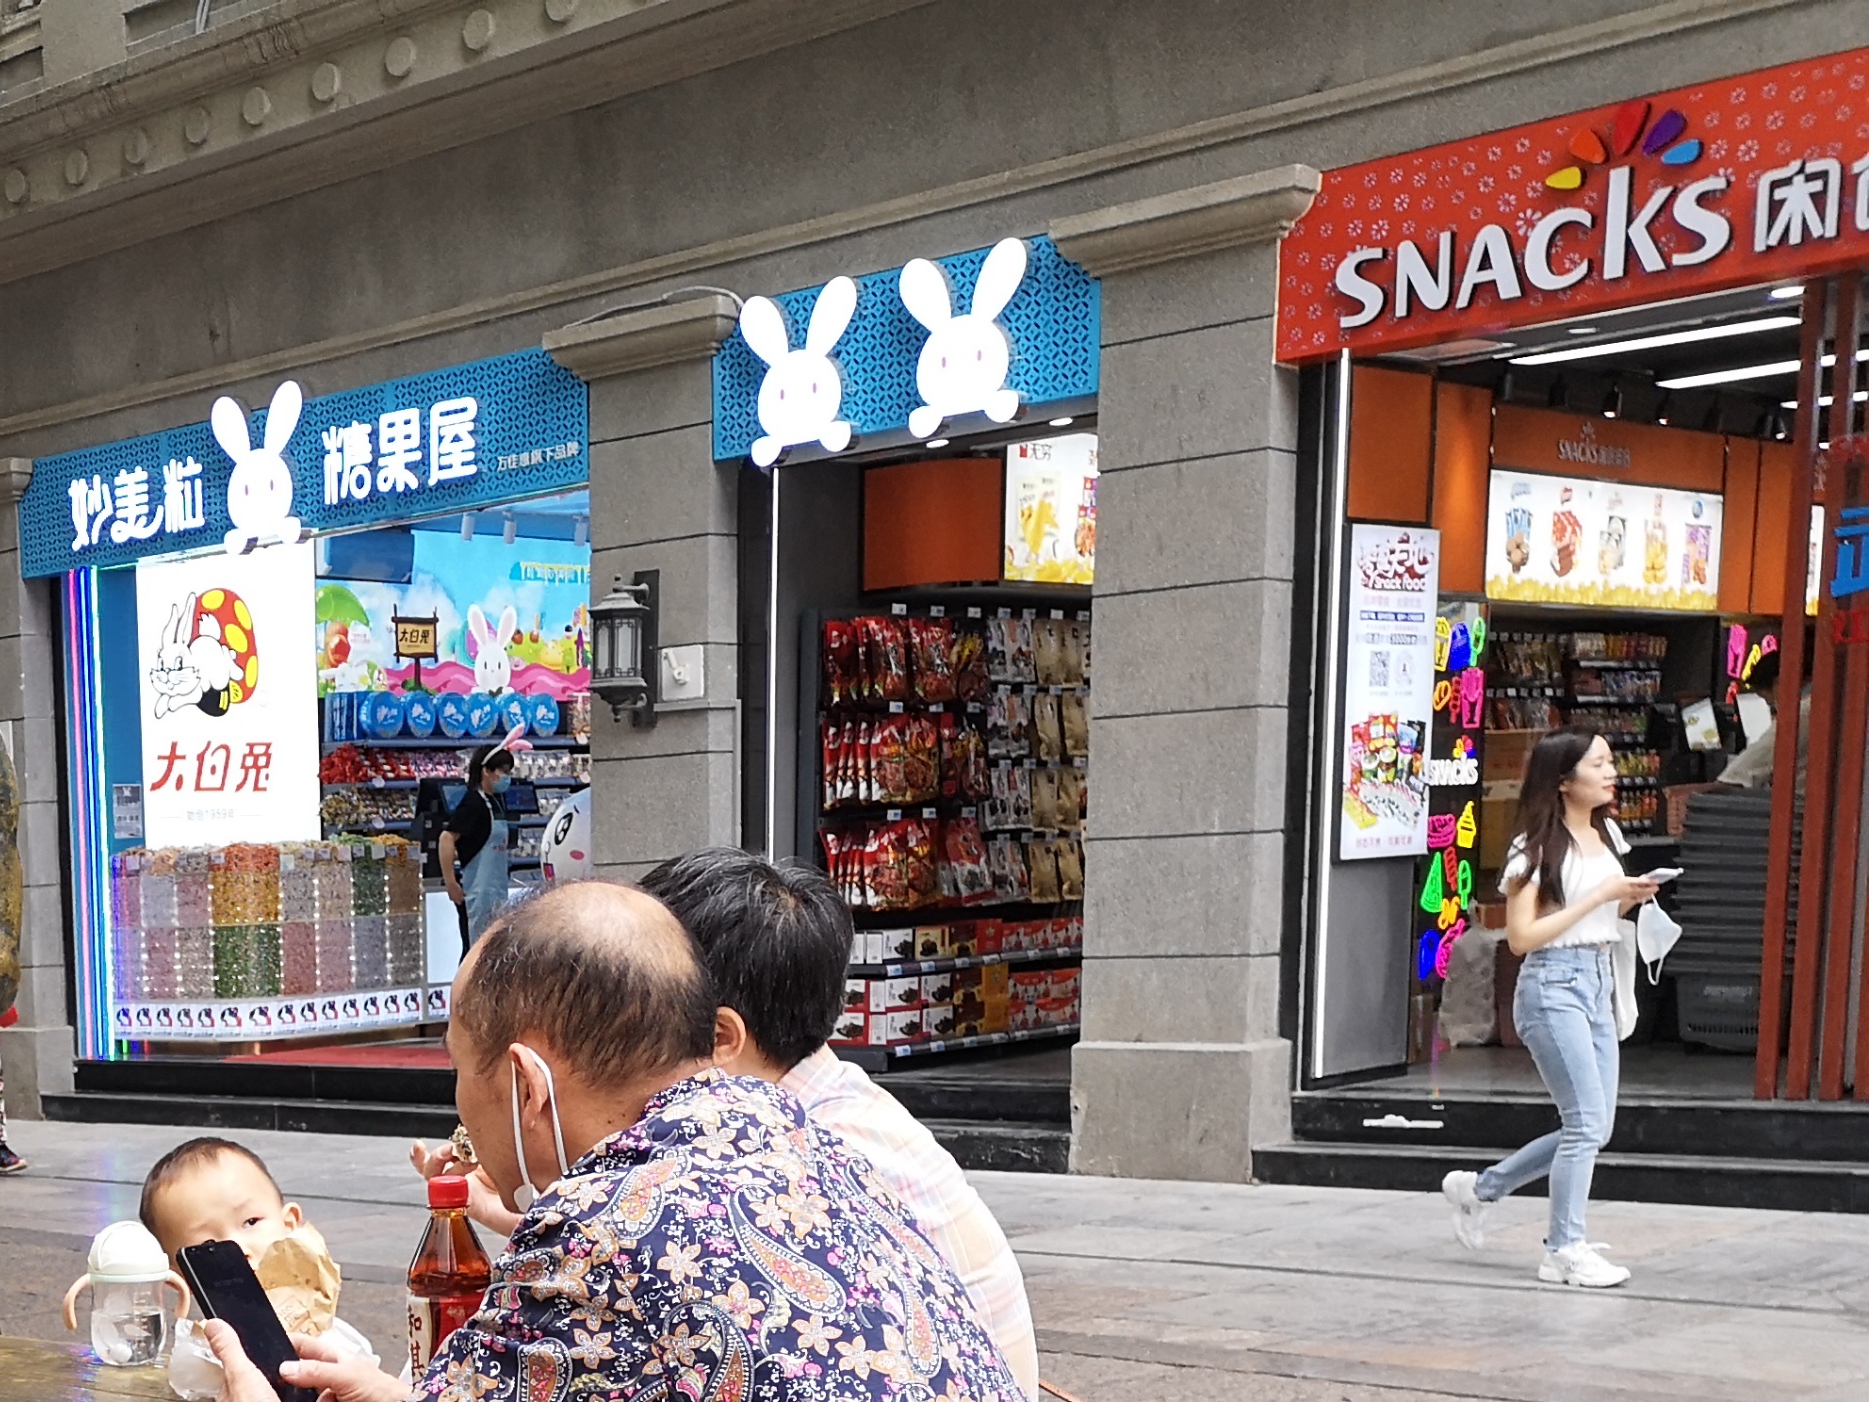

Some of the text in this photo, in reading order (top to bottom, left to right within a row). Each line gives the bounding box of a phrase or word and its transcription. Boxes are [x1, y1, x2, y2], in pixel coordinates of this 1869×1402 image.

[1753, 158, 1869, 253] 闲
[70, 396, 479, 552] 妙美粒 糖果屋
[398, 627, 431, 645] 大白兔
[149, 740, 273, 793] 大白兔
[408, 1303, 427, 1392] 和其
